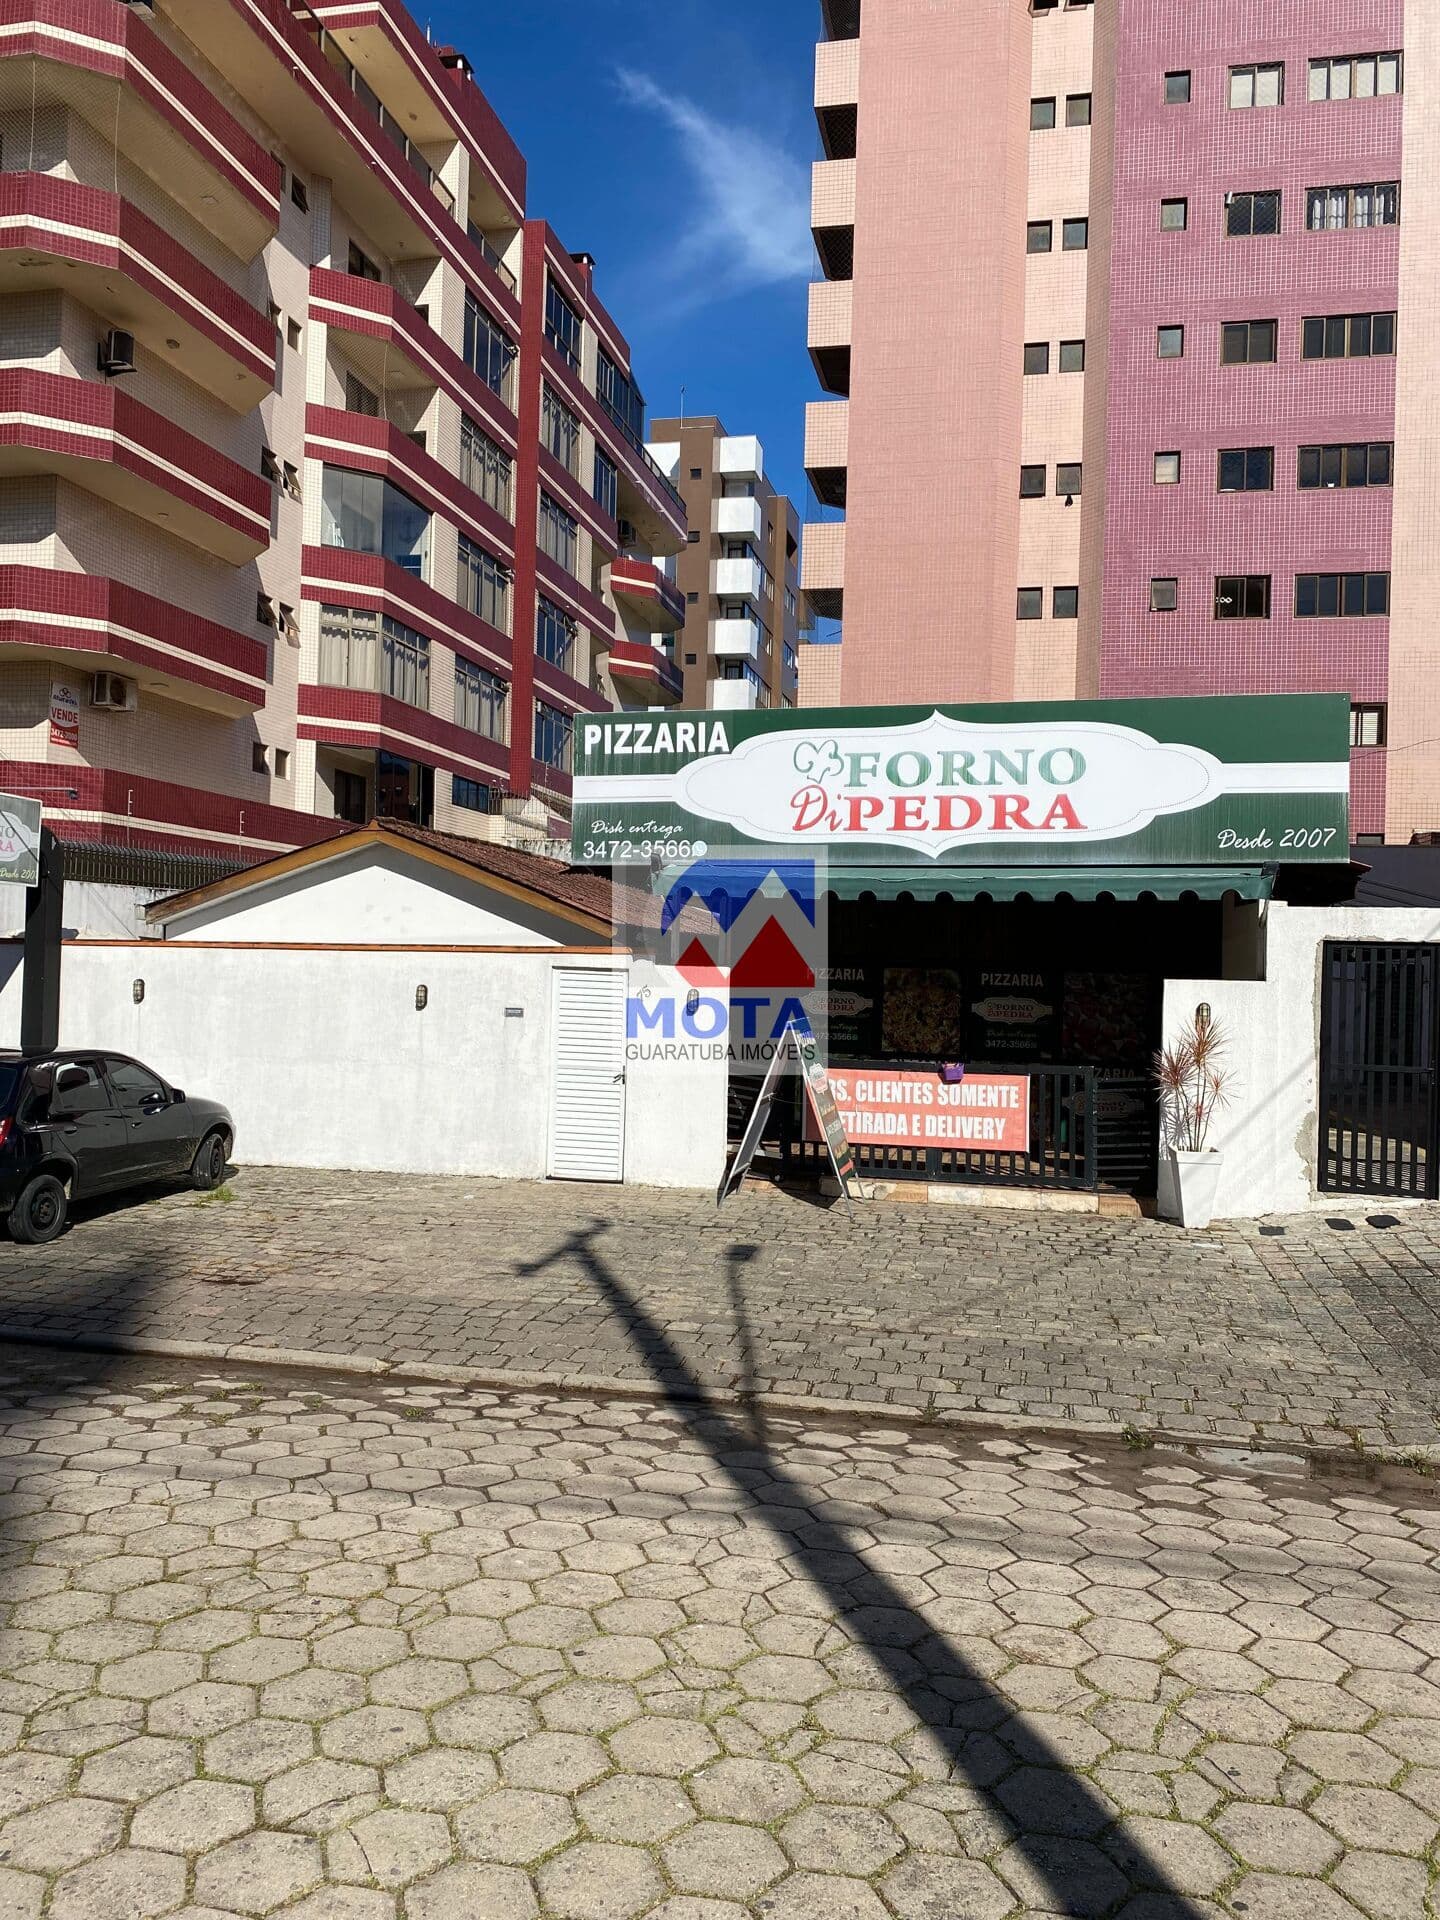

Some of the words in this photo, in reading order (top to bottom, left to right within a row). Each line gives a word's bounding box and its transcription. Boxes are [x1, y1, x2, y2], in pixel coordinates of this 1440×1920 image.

[51, 707, 78, 723] VENDE
[584, 721, 730, 755] PIZZARIA
[844, 747, 1088, 788] FORNO
[790, 784, 843, 832] Di
[843, 793, 1088, 832] PEDRA
[591, 820, 624, 834] Disk
[629, 819, 684, 839] entrega
[1218, 829, 1273, 849] Desde
[1279, 828, 1337, 849] 2007
[583, 840, 691, 859] 3472-3566
[981, 972, 1044, 987] PIZZARIA
[856, 1080, 933, 1105] CLIENTES
[938, 1083, 1019, 1109] SOMENTE
[839, 1110, 908, 1136] ETIRADA
[912, 1115, 920, 1136] E
[926, 1114, 1006, 1140] DELIVERY
